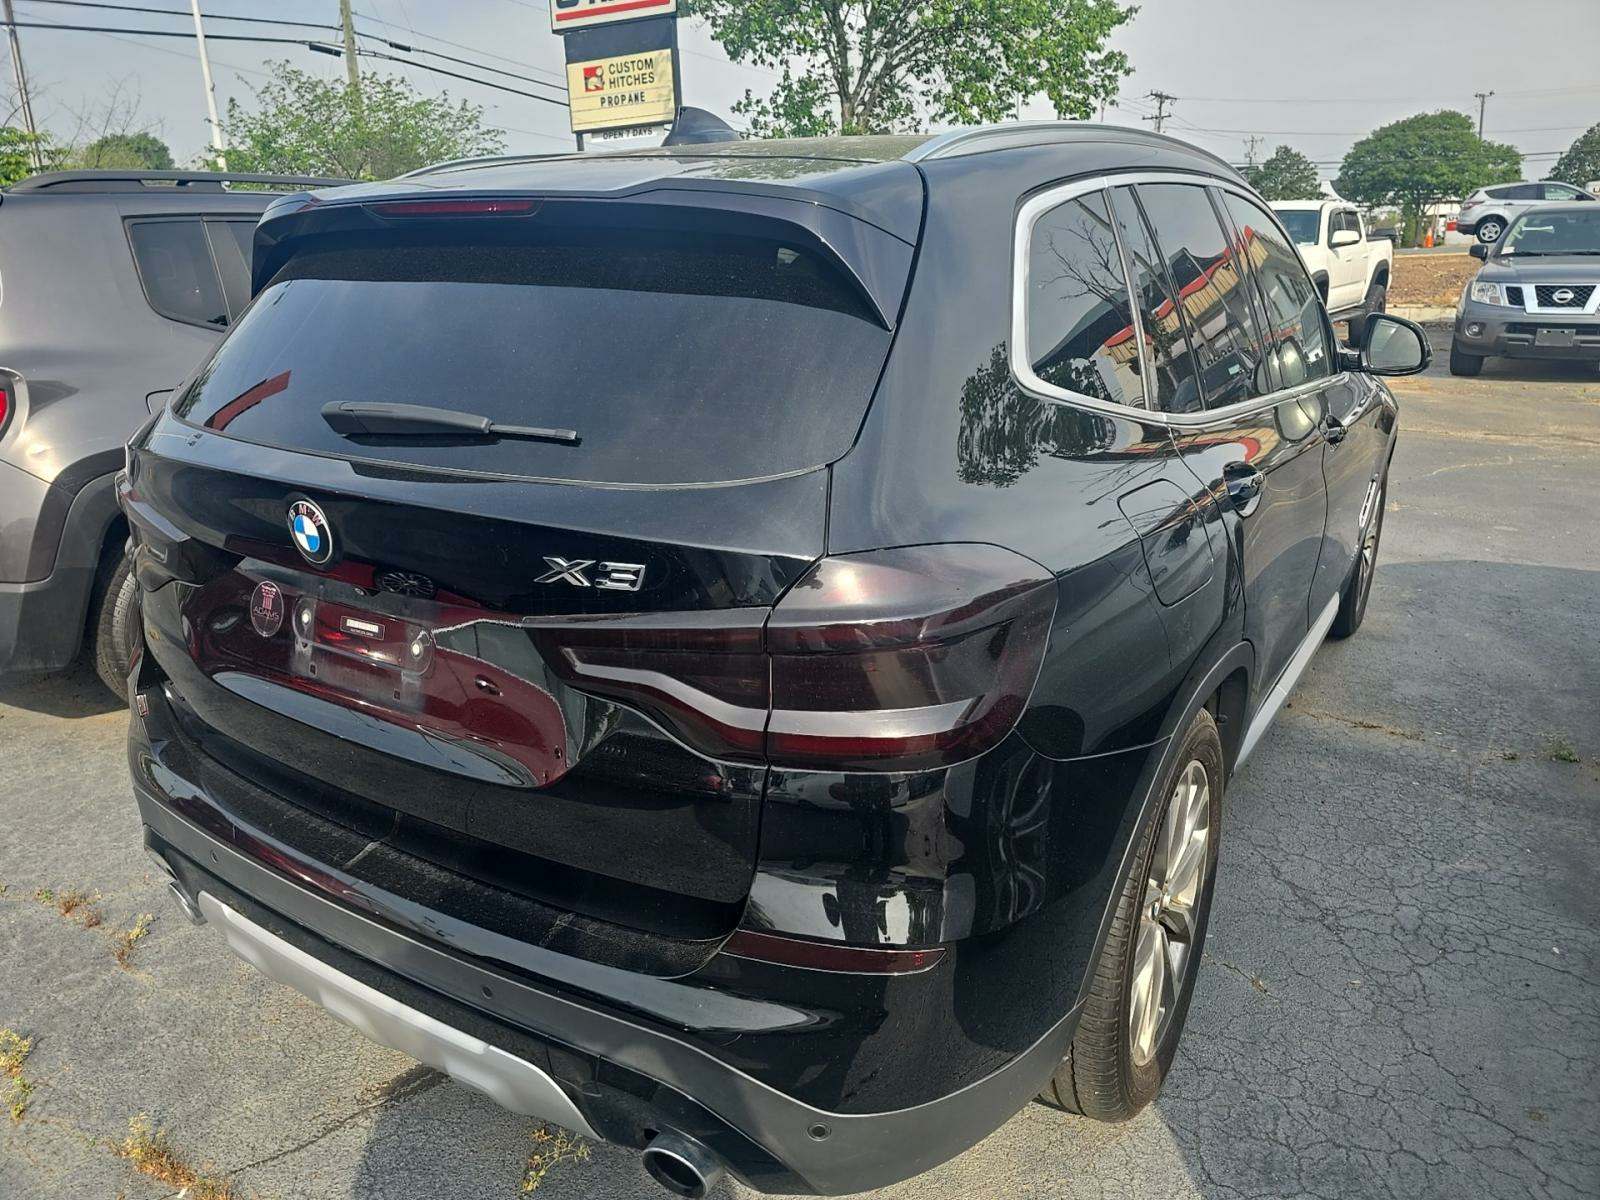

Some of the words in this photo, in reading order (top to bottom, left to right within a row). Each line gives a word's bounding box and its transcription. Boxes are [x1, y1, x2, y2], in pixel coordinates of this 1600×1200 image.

[608, 58, 654, 76] CUSTOM
[608, 72, 655, 89] HITCHES
[600, 91, 646, 107] PROPANE
[602, 129, 624, 140] OPEN
[625, 128, 631, 138] 7
[632, 127, 653, 137] DAYS
[290, 503, 322, 527] BMW
[533, 556, 646, 592] X3
